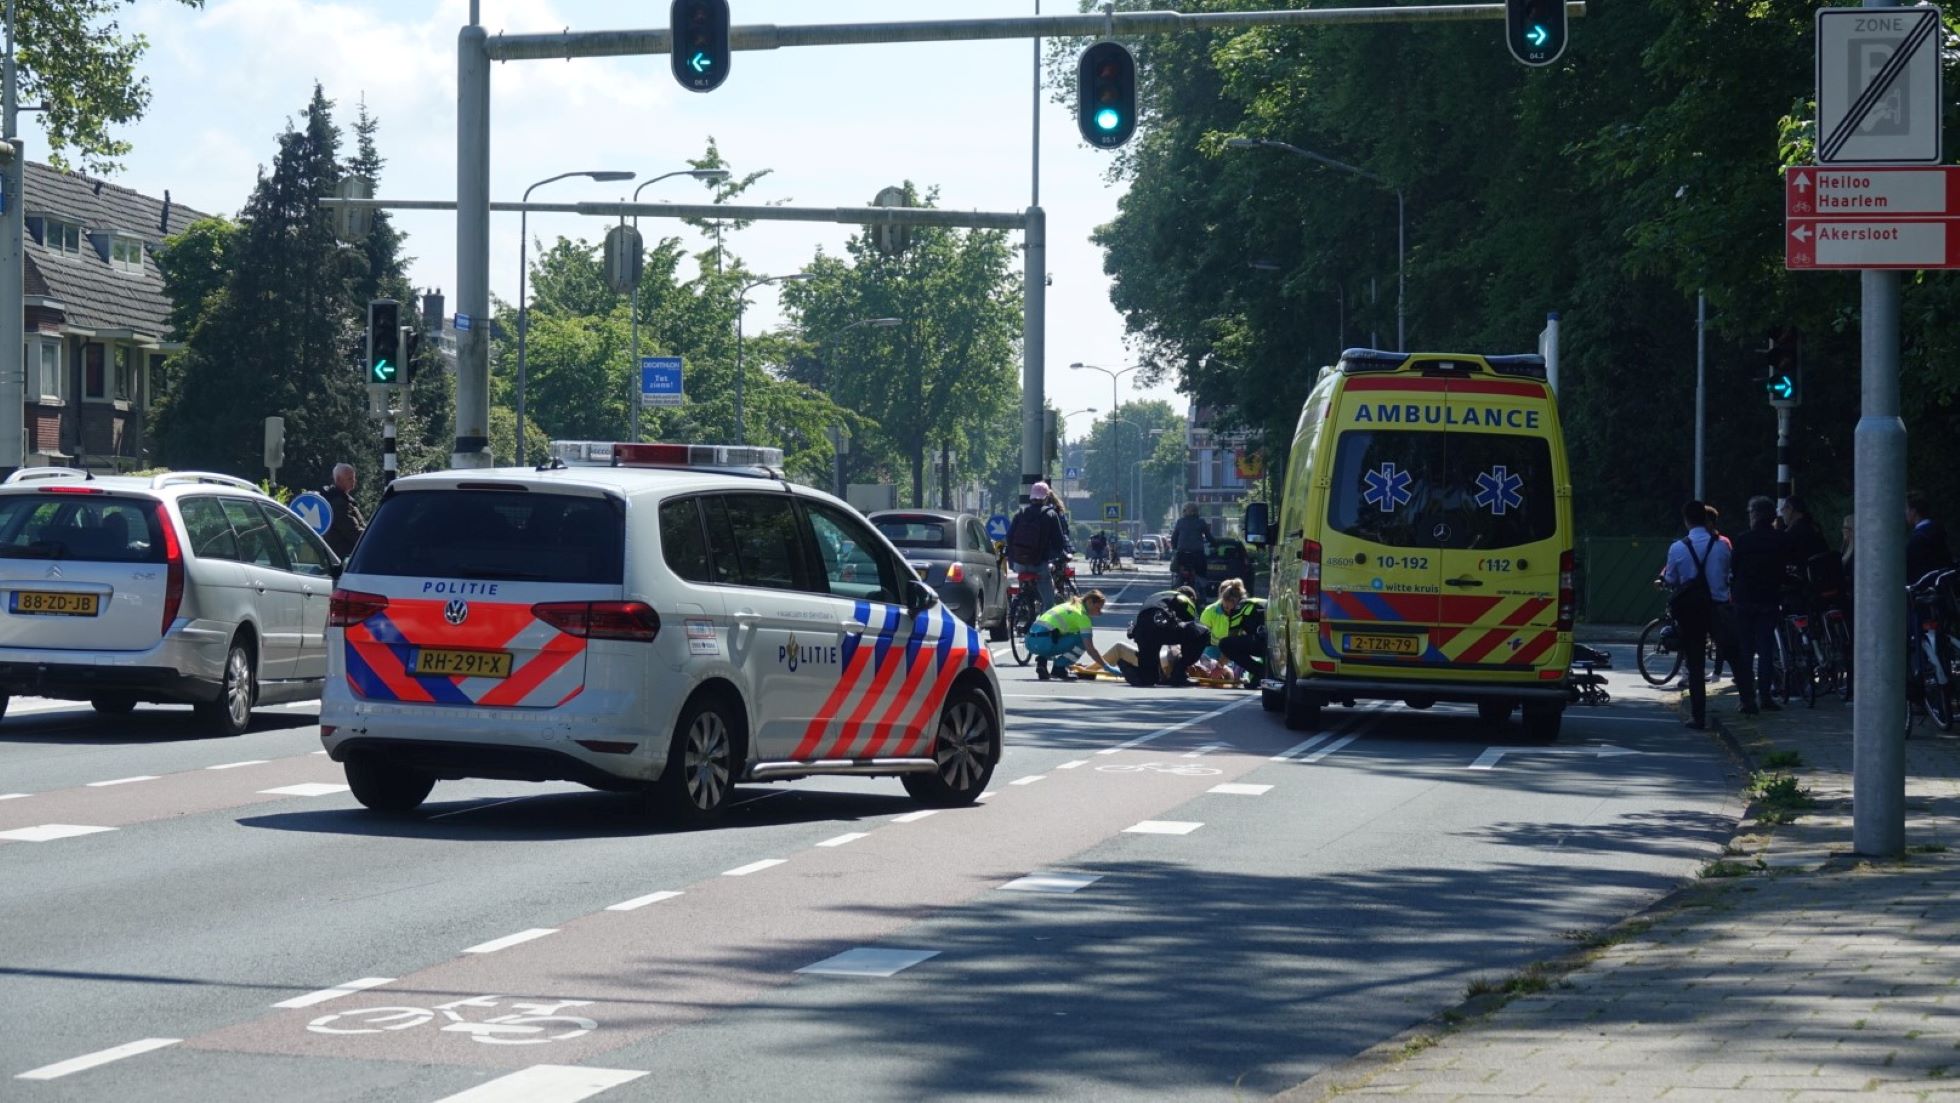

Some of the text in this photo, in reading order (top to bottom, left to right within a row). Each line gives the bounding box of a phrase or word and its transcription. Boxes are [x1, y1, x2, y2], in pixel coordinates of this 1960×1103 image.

[1855, 18, 1904, 32] ZONE
[1819, 175, 1870, 188] Heiloo
[1819, 194, 1888, 207] Haarlem
[1818, 228, 1898, 241] Akersloot
[1354, 404, 1540, 429] AMBULANCE
[1376, 556, 1429, 570] 10-192
[1486, 559, 1511, 572] 112
[422, 581, 499, 595] POLITIE
[1386, 583, 1440, 594] witte kruis
[23, 595, 91, 611] 88-ZD-JB
[1355, 637, 1411, 651] 2-TZR-79
[422, 653, 502, 673] RH-291-X
